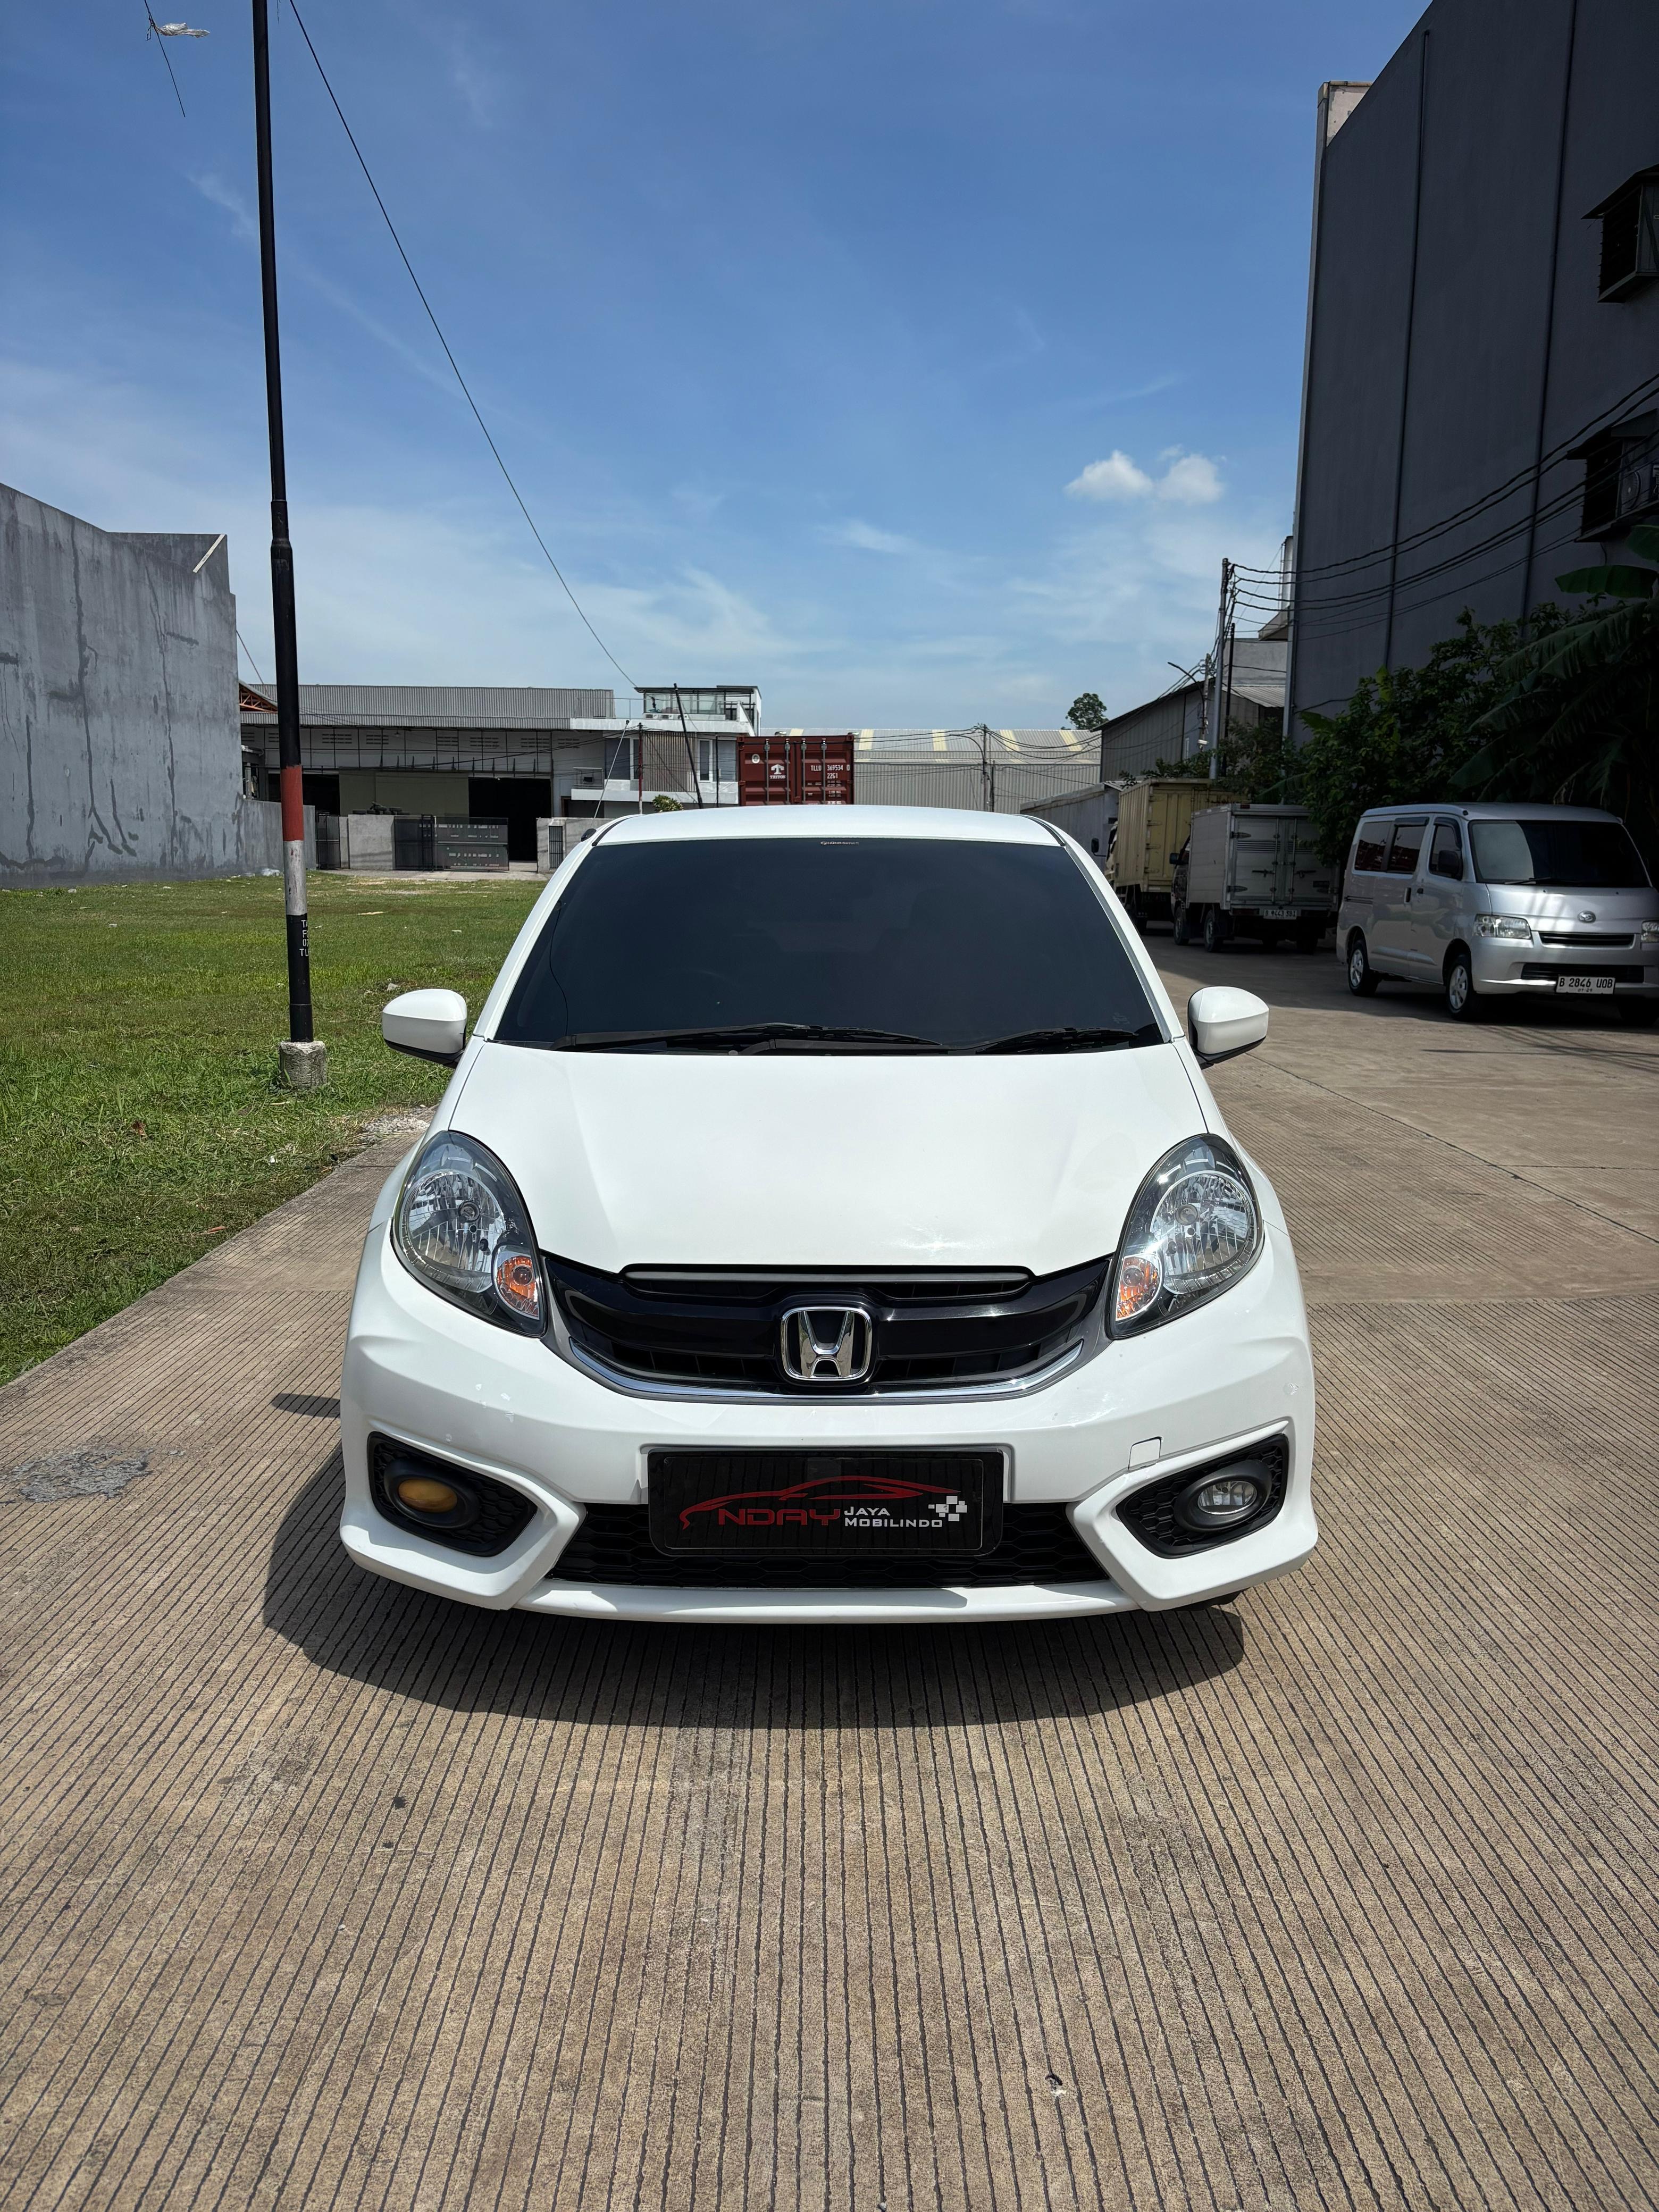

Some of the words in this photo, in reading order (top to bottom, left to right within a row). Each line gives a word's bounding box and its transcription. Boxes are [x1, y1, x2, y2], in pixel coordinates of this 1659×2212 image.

[1559, 977, 1565, 987] B
[1569, 978, 1591, 987] 2846
[1596, 978, 1613, 988] UOB
[844, 1506, 890, 1515] JAYA
[845, 1518, 942, 1527] MOBILINDO
